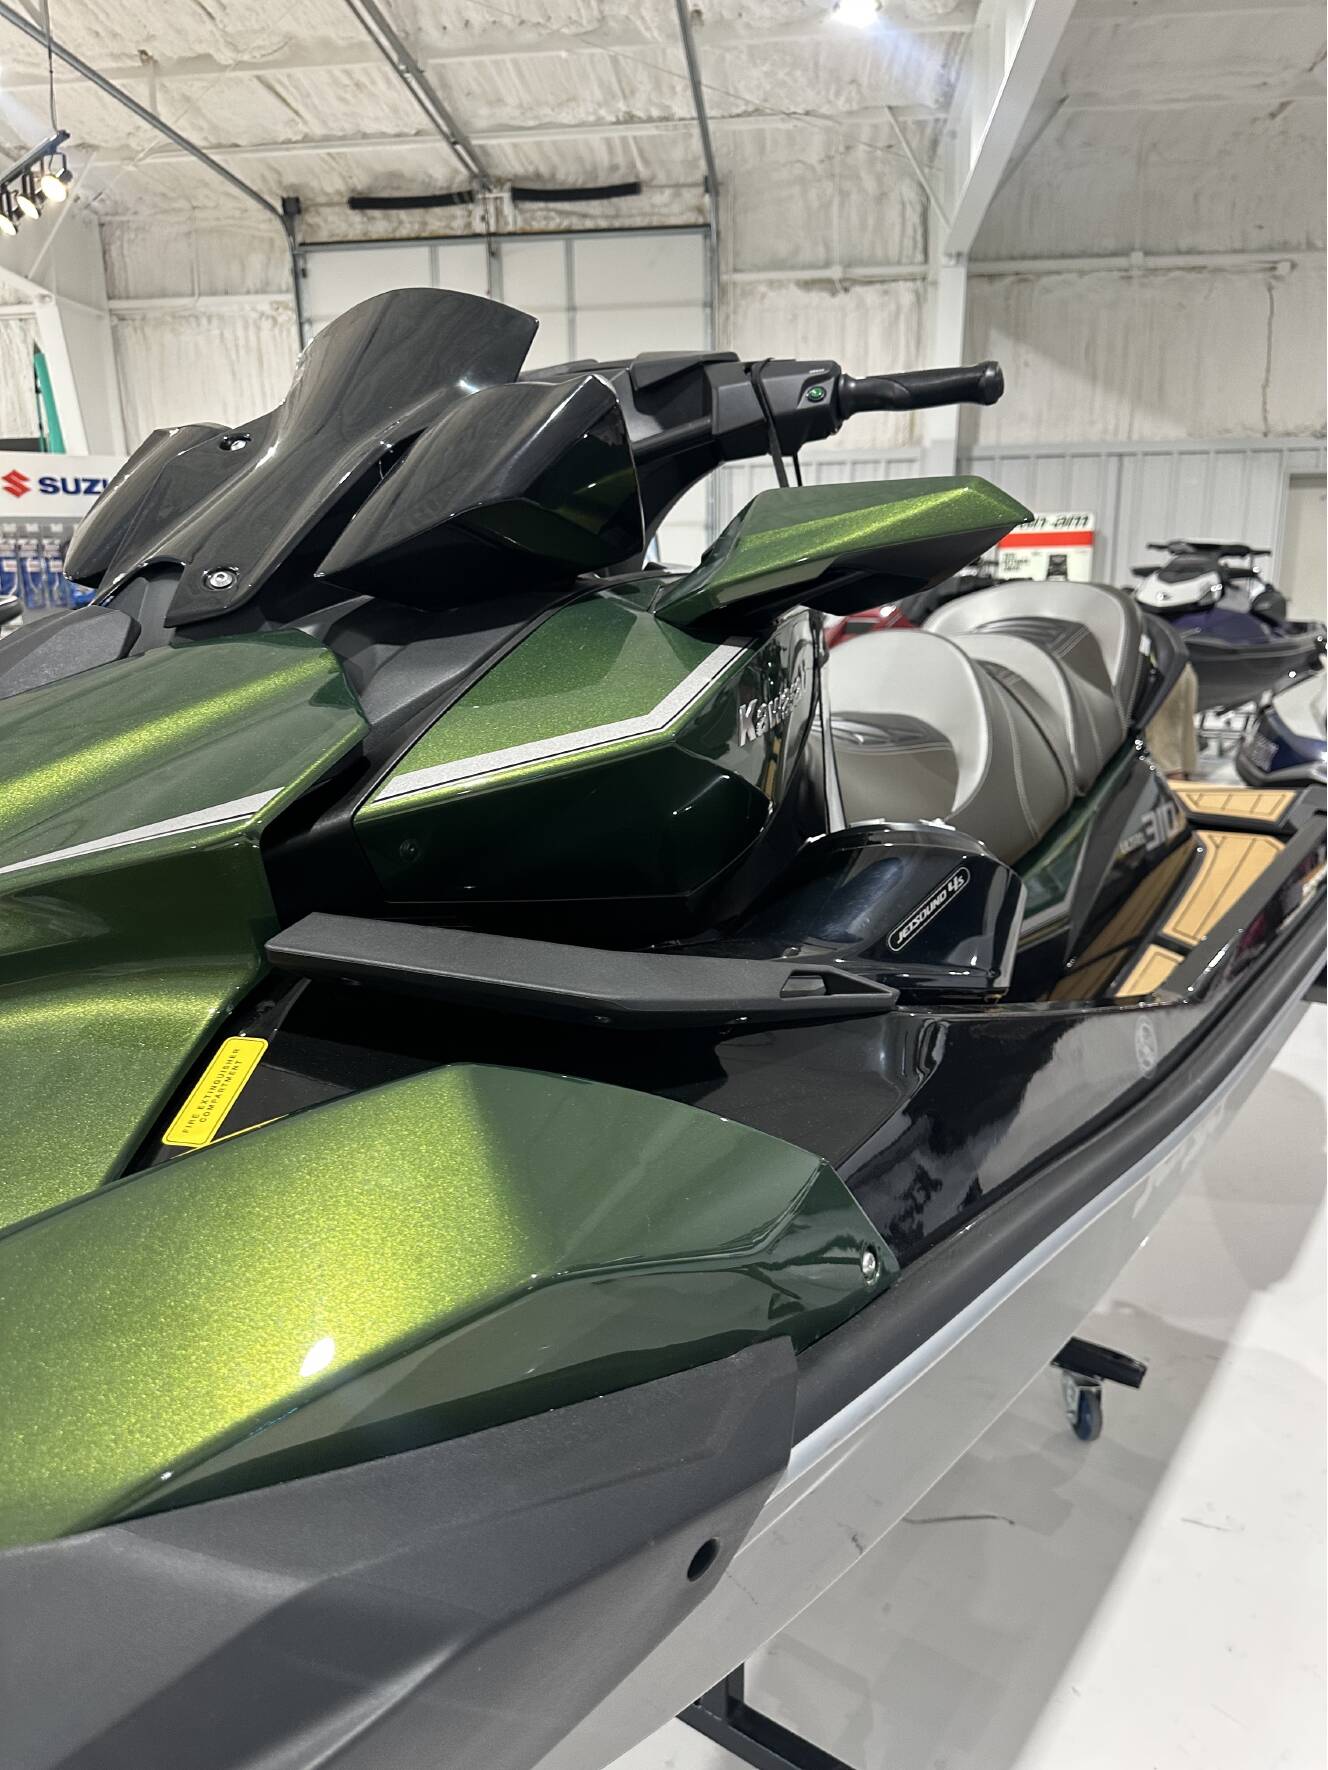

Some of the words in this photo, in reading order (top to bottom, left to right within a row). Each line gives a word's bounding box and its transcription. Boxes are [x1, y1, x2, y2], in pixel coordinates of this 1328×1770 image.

[1141, 801, 1182, 852] 310
[897, 889, 948, 945] JETSOUND
[182, 1113, 200, 1134] FIRE
[197, 1048, 240, 1110] EXTINGUISHER
[199, 1060, 243, 1123] COMPARTMENT
